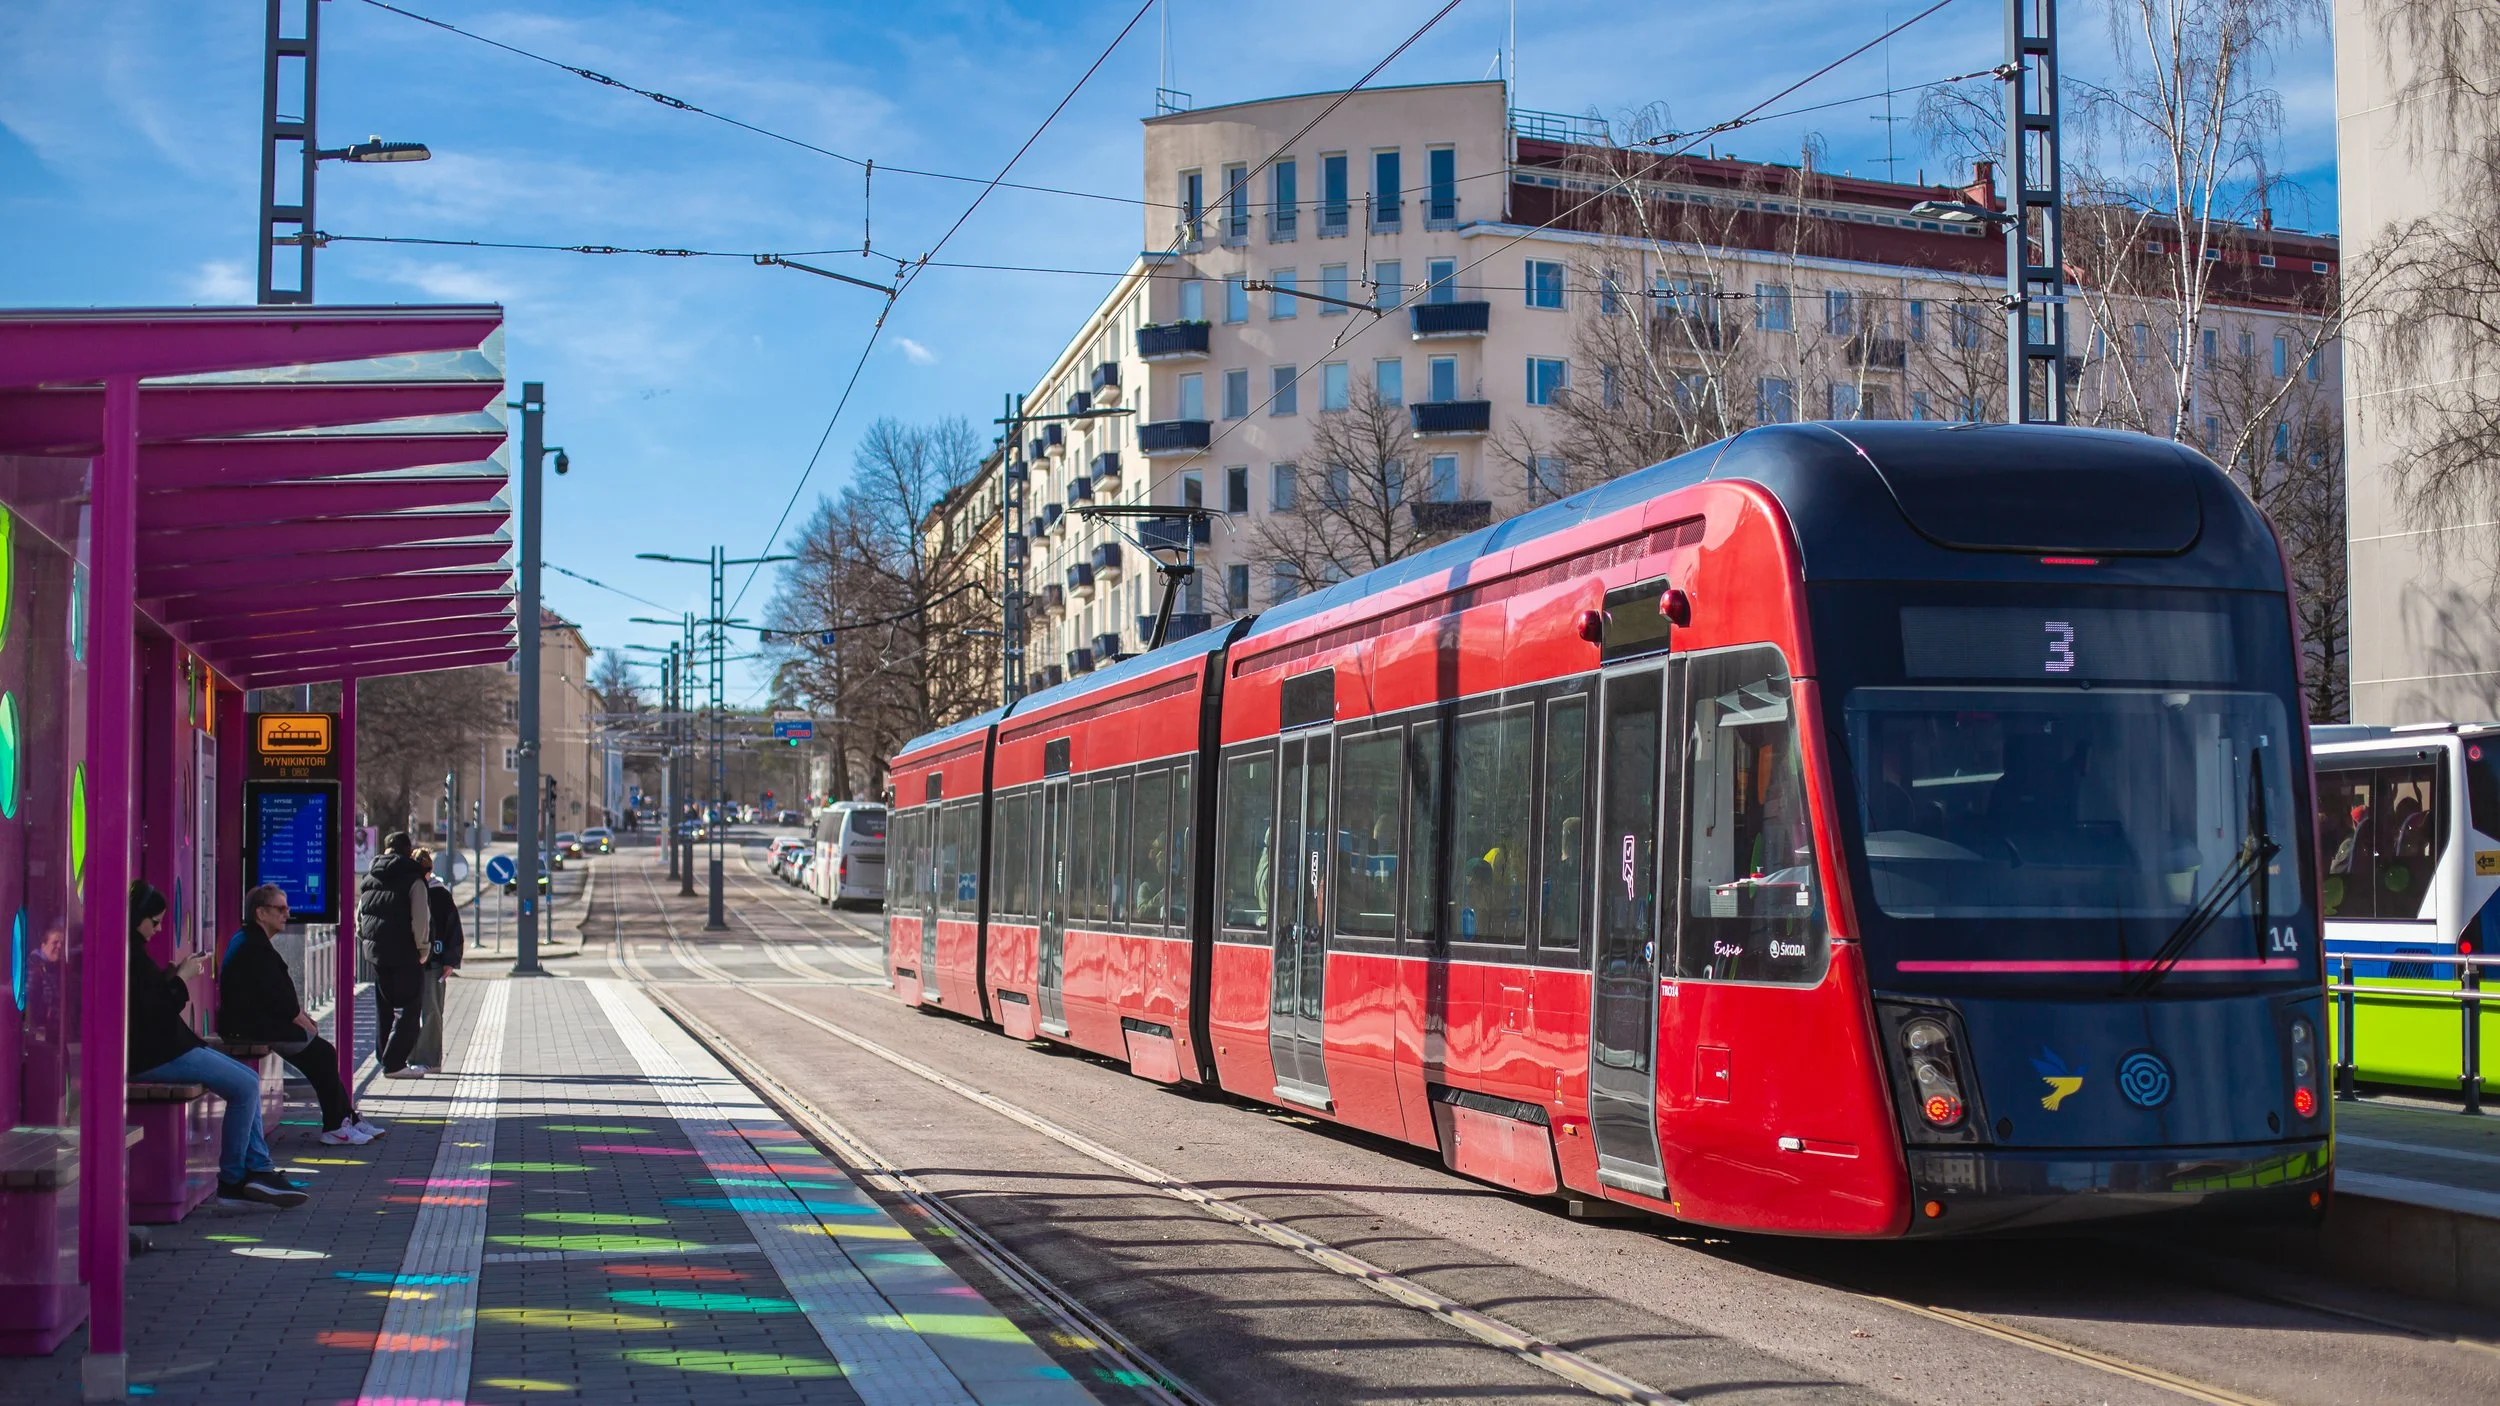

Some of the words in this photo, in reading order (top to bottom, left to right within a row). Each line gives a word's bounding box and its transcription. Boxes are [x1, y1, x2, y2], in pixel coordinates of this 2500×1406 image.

[2044, 621, 2075, 672] 3
[263, 756, 326, 767] PYYNIKINTORI
[291, 768, 310, 777] 0802
[2269, 926, 2298, 952] 14
[1780, 942, 1806, 957] ŠKODA
